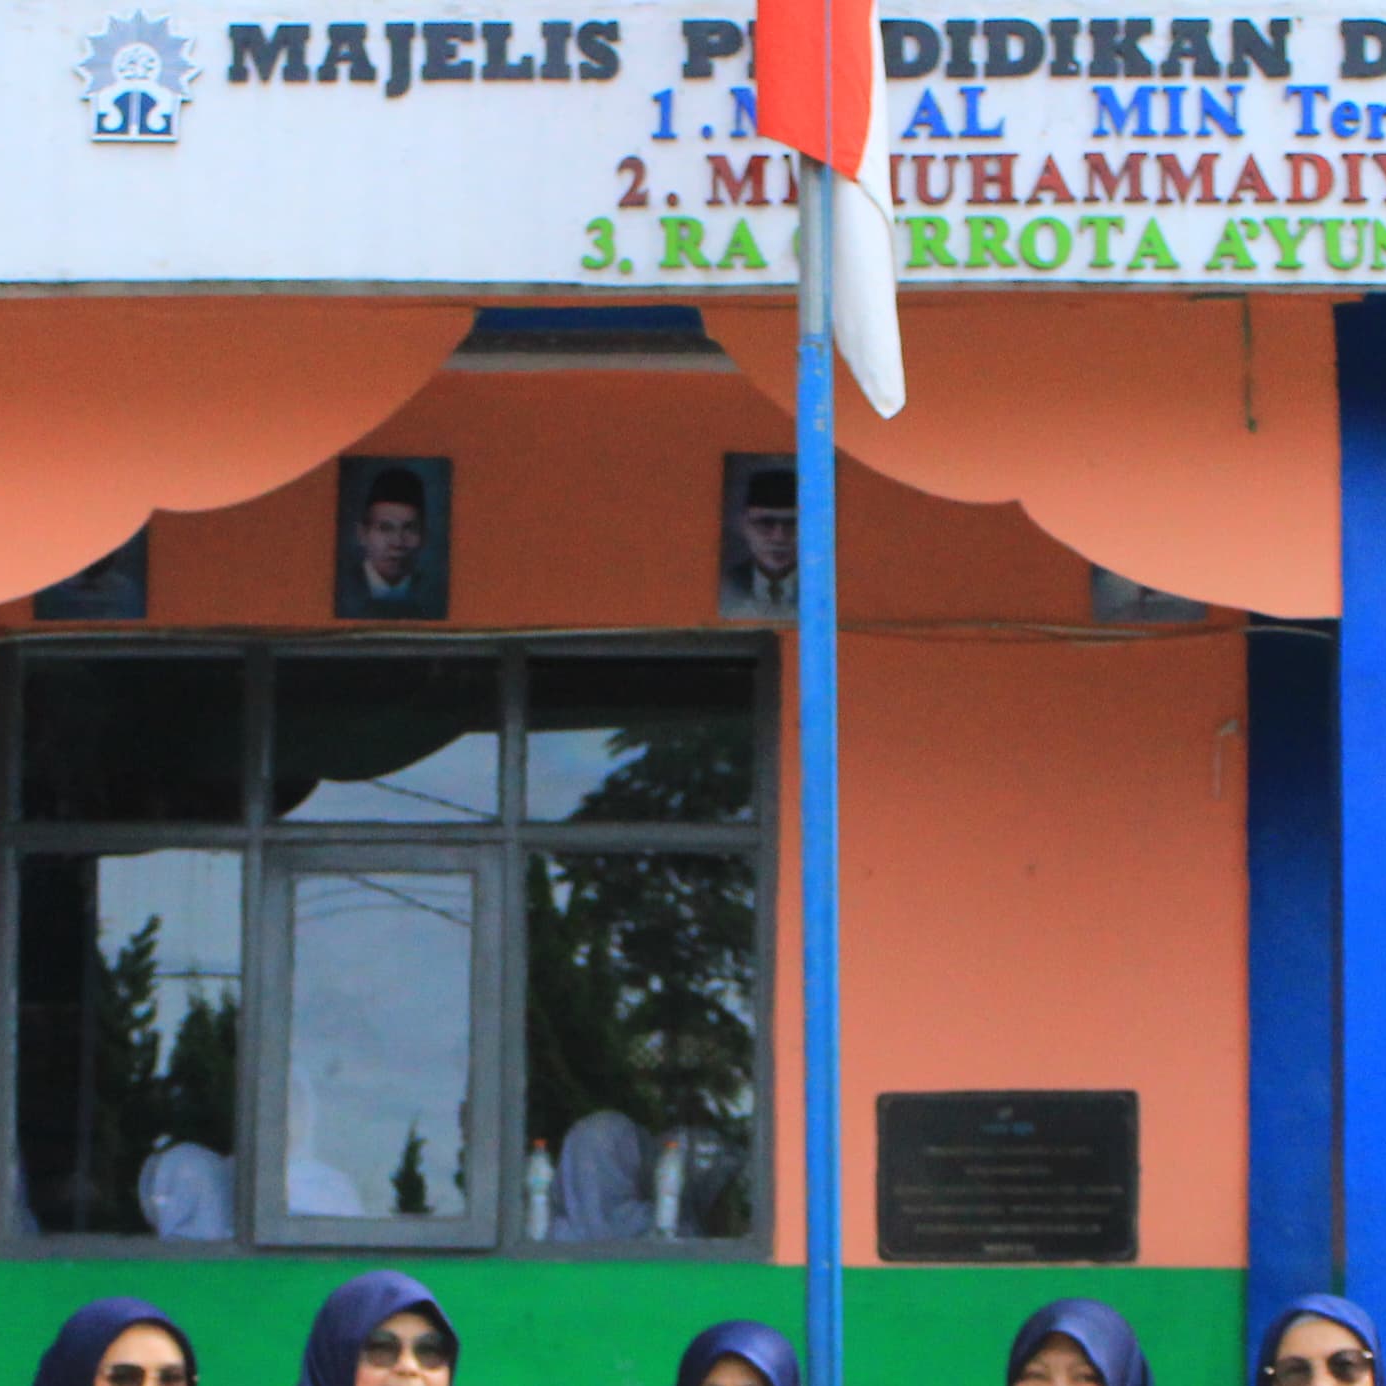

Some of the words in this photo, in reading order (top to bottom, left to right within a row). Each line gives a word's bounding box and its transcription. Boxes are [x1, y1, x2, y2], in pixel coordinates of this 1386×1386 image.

[227, 21, 621, 98] MAJELIS
[681, 19, 1292, 80] PDIDIKAN
[902, 86, 1006, 140] AL
[658, 215, 769, 270] RA
